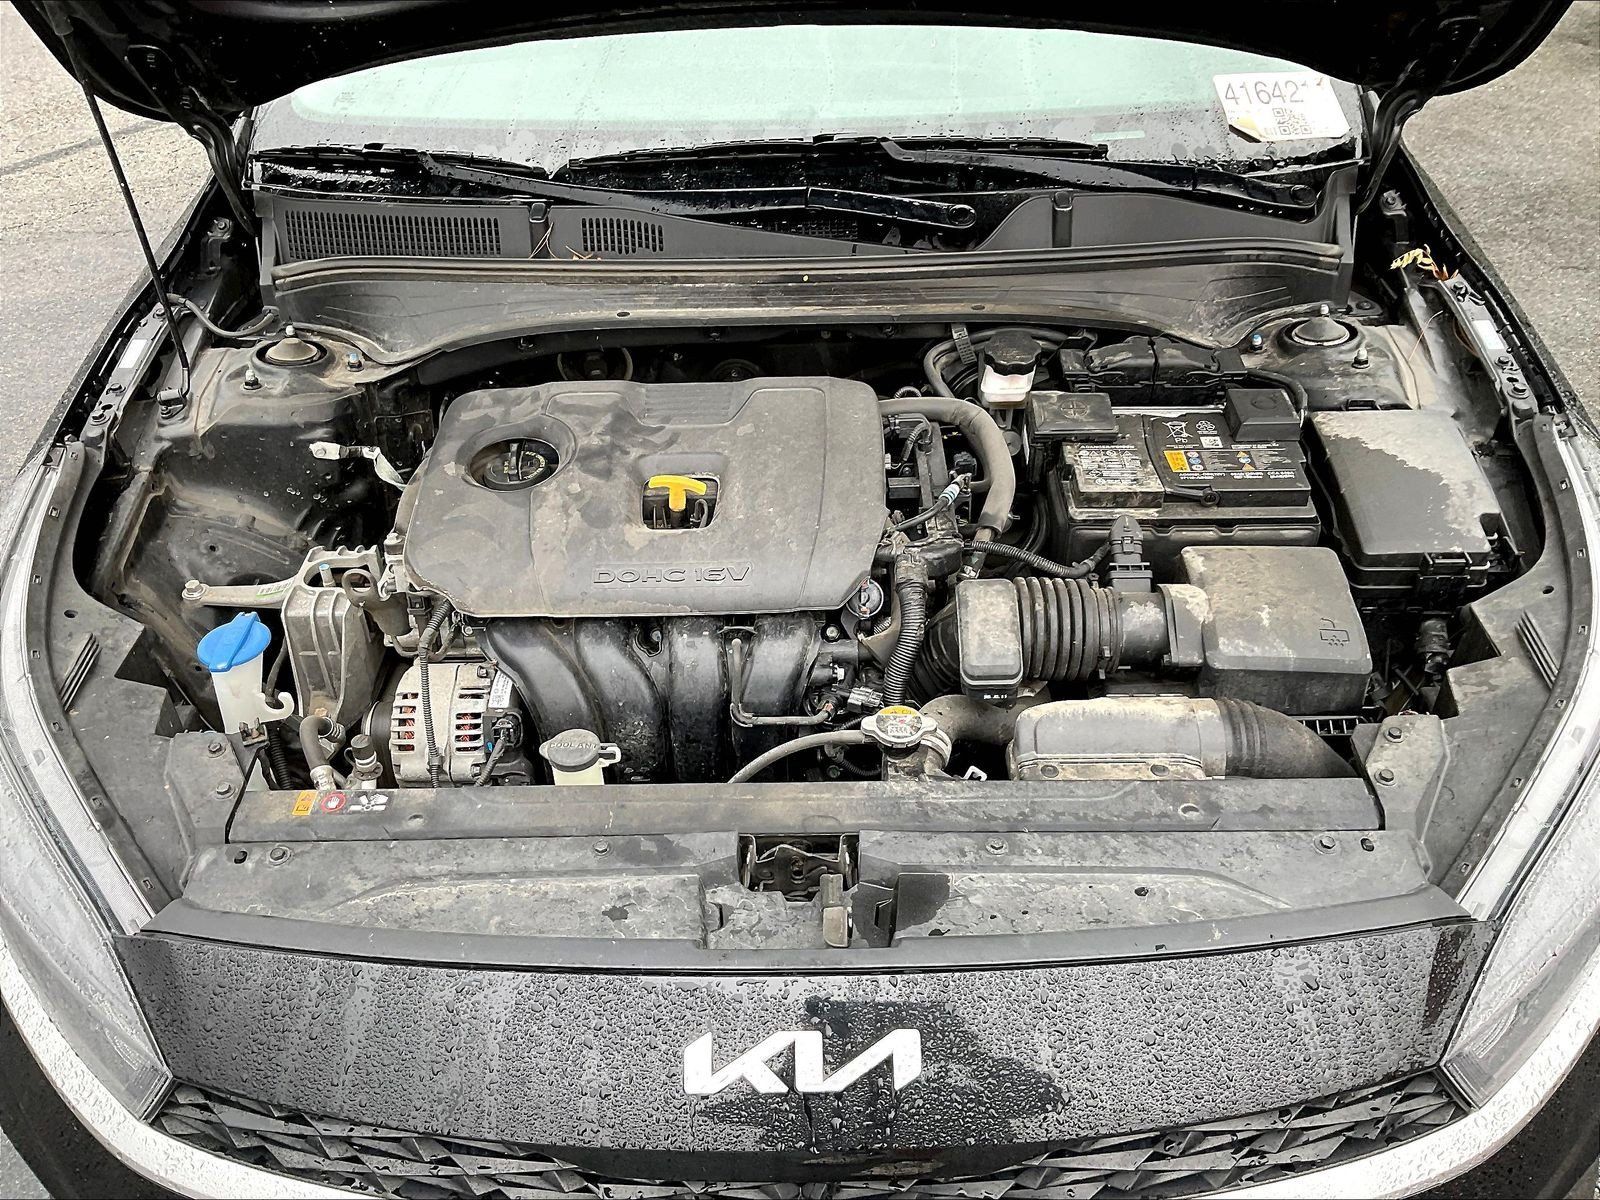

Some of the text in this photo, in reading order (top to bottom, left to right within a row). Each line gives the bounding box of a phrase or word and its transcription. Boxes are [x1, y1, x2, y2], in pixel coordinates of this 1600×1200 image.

[593, 565, 752, 584] DOHC 16V
[549, 741, 598, 750] COOLANT
[683, 1028, 922, 1095] KIA
